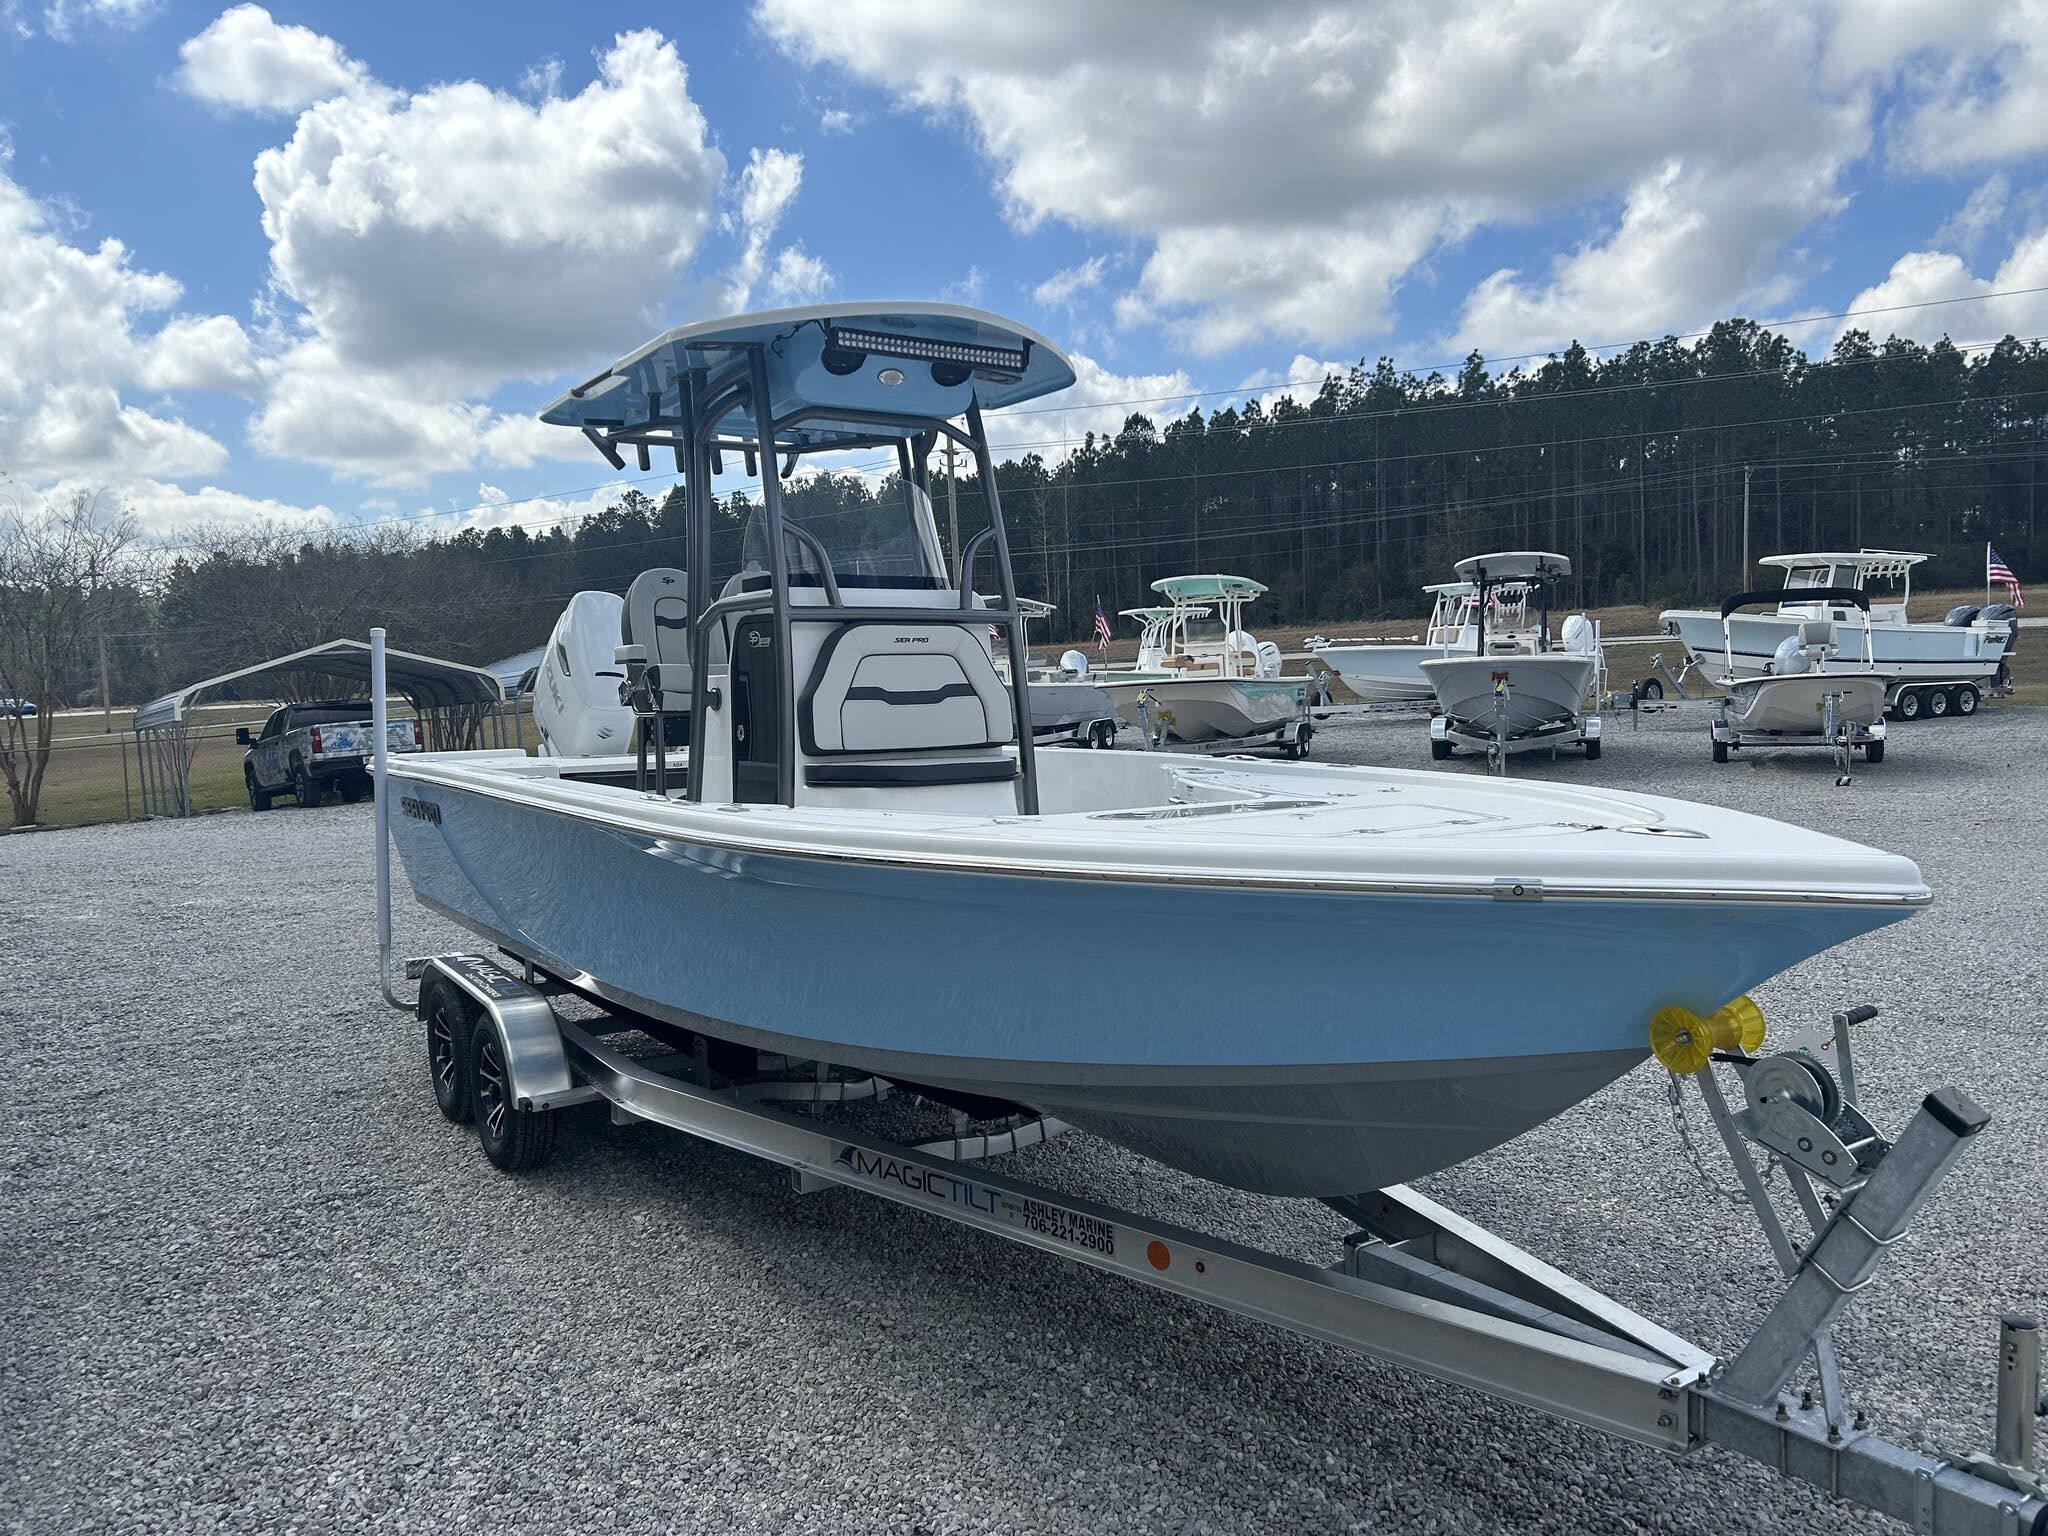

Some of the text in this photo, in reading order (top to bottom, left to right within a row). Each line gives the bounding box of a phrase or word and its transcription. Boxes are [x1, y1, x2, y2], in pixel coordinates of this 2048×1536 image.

[857, 1150, 1002, 1214] MAGICTILT
[1023, 1199, 1066, 1225] ASHLEY
[1068, 1213, 1113, 1240] MARINE
[1023, 1213, 1114, 1255] 706-221-2900
